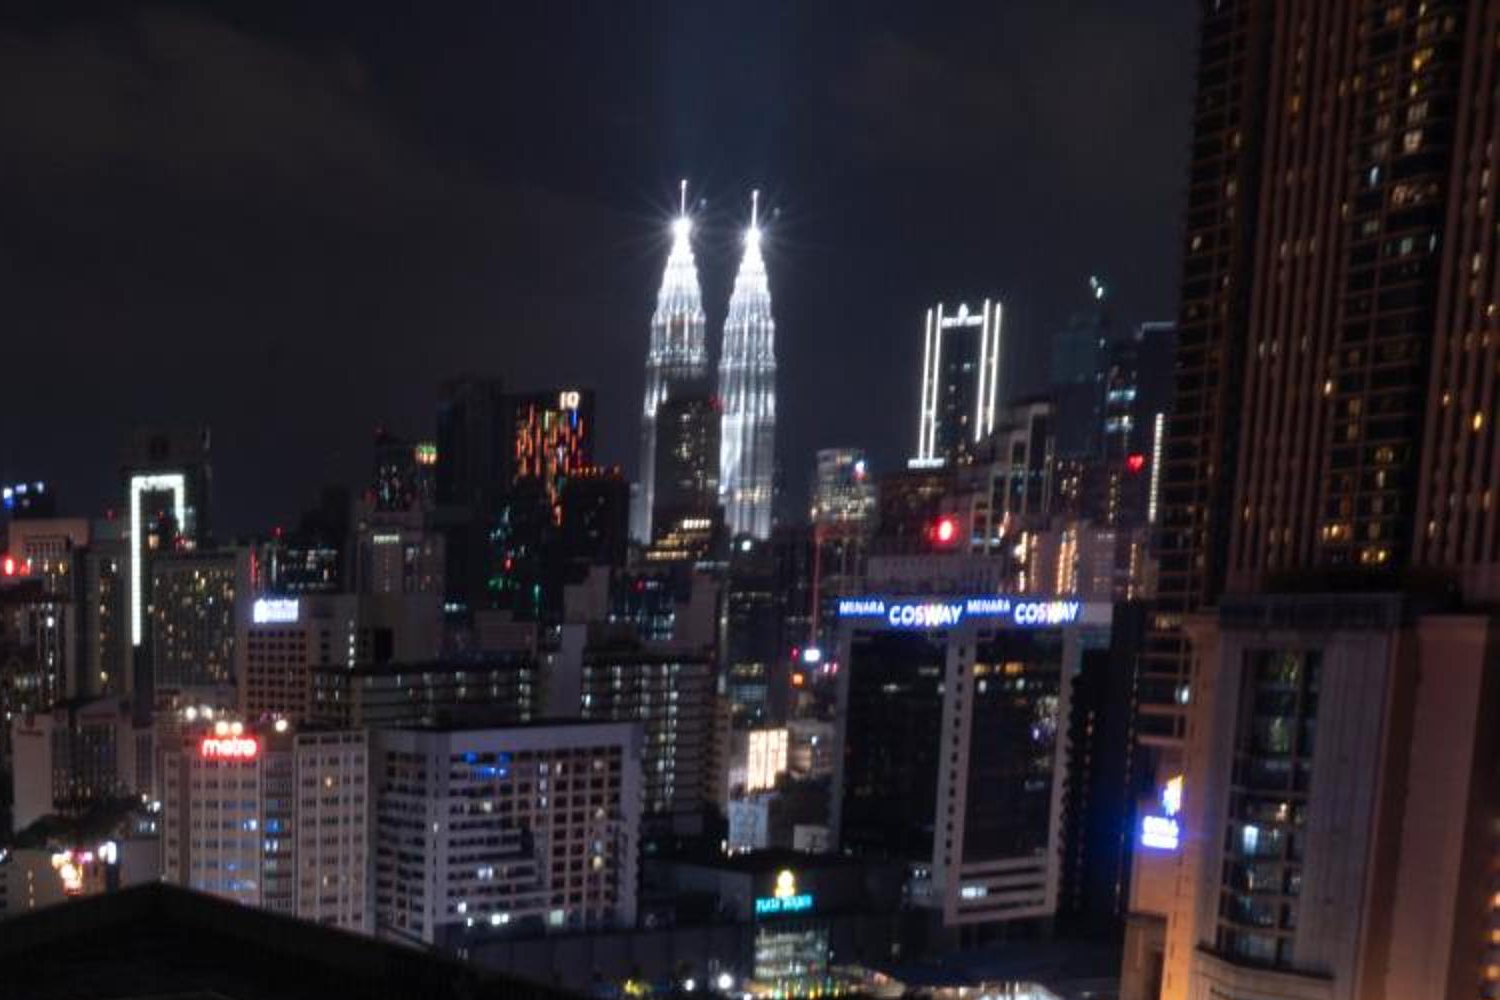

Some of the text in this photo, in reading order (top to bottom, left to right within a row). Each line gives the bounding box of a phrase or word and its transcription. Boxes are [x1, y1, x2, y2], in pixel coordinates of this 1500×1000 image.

[839, 601, 963, 625] MENARA COSWAY
[1014, 602, 1079, 624] COSWAY
